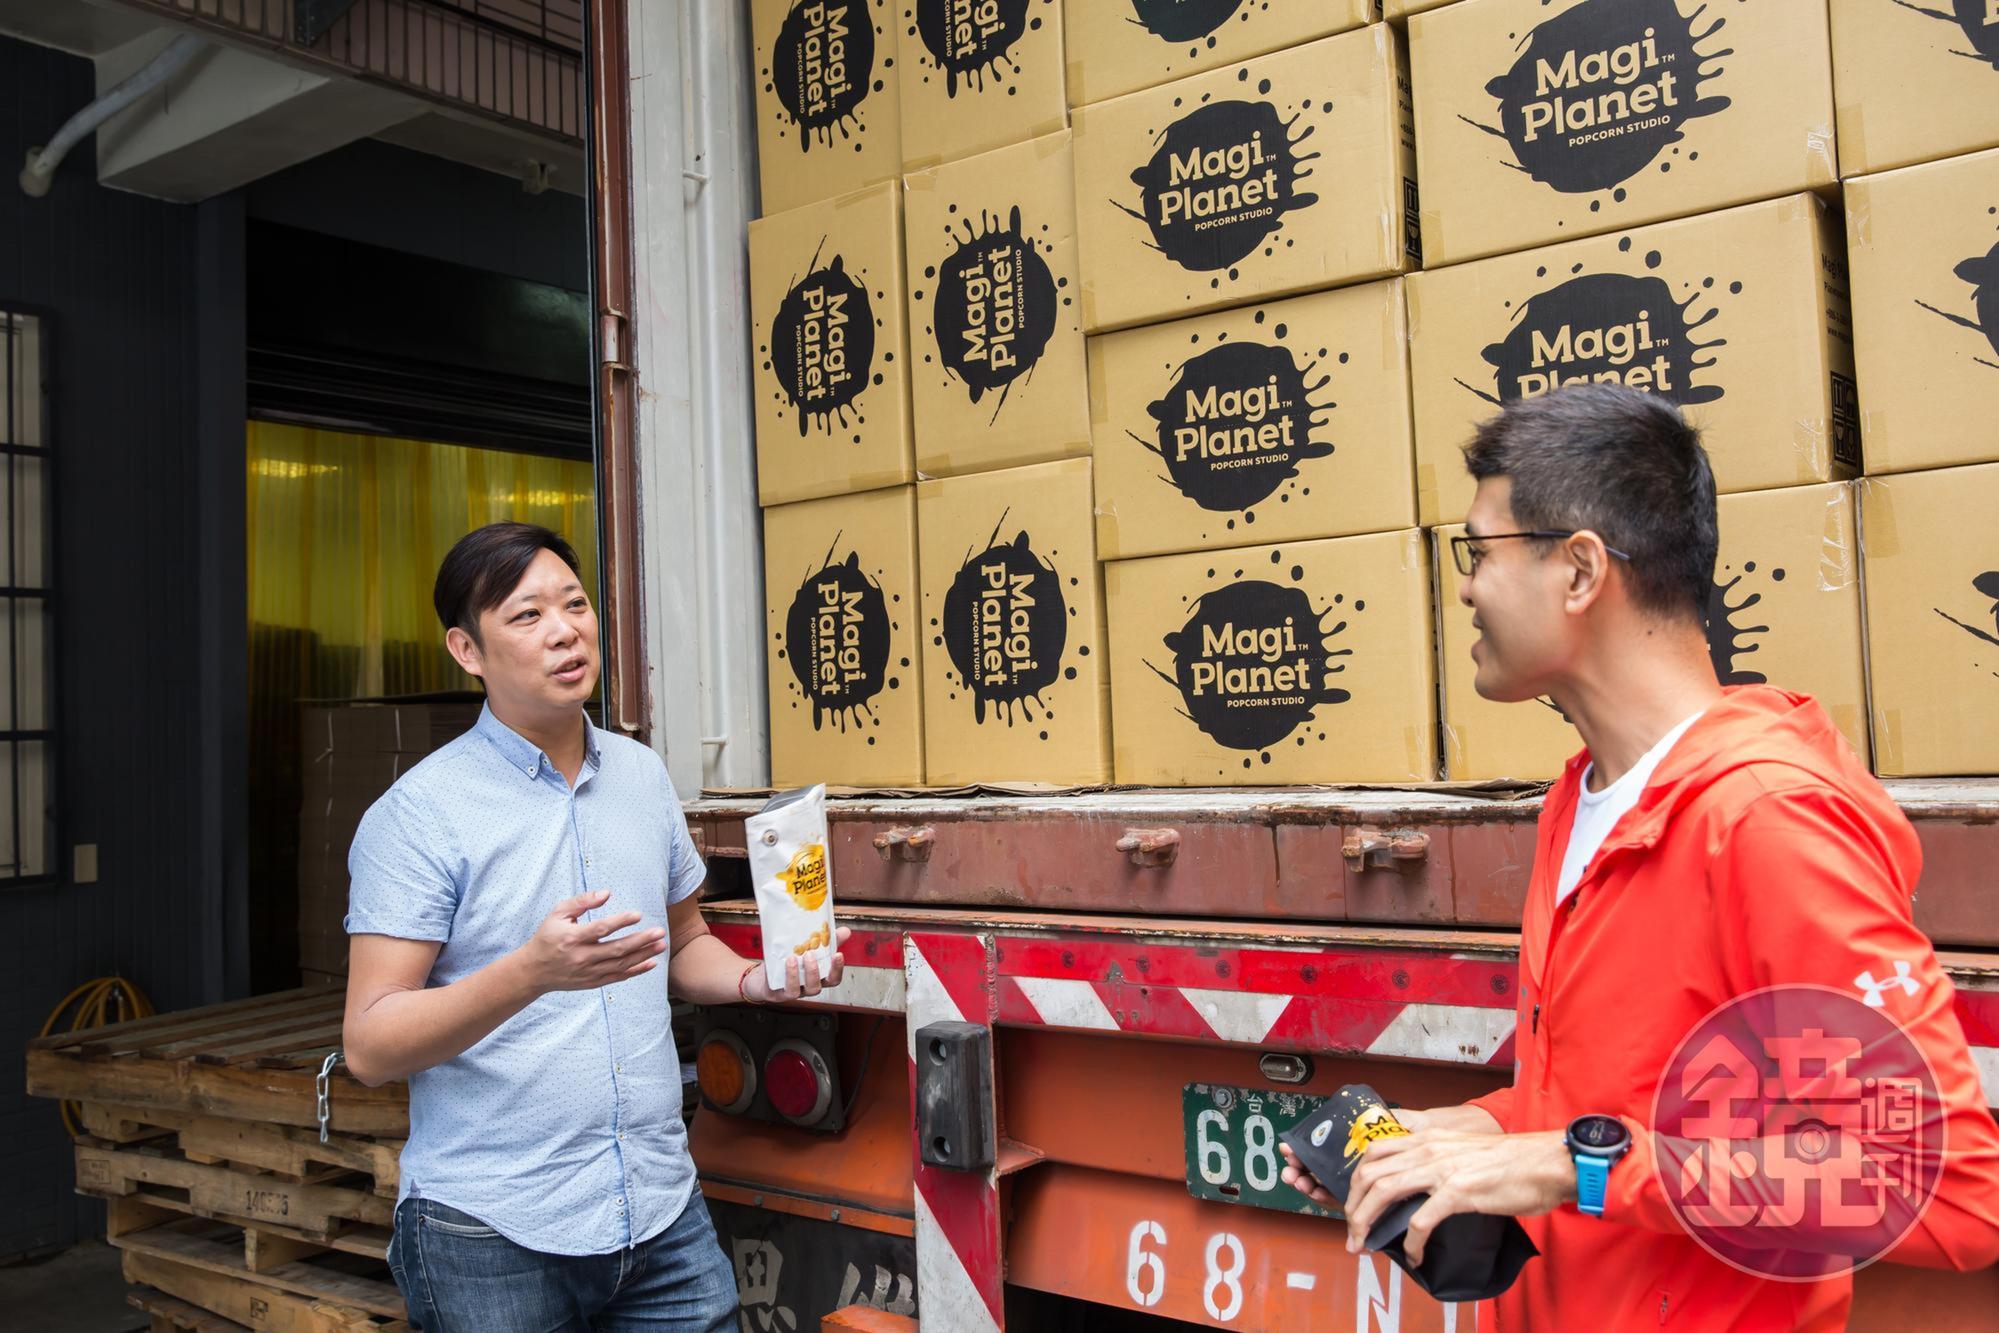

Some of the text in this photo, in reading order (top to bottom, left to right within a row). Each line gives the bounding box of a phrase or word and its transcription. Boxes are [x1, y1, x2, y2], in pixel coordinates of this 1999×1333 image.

[803, 0, 827, 117] Planet
[824, 5, 852, 98] Magi
[1535, 27, 1660, 97] Magi
[1521, 70, 1678, 143] Planet
[1568, 114, 1671, 148] POPCORN STUDIO
[1169, 130, 1264, 187] Magi
[1158, 169, 1279, 226] Planet
[1194, 206, 1273, 232] POPCORN STUDIO
[959, 263, 991, 362] Magi
[988, 245, 1016, 371] Planet
[1015, 249, 1025, 329] POPCORN STUDIO
[803, 286, 826, 401] Planet
[823, 293, 852, 385] Magi
[1531, 309, 1653, 369] Magi
[1185, 374, 1280, 423] Magi
[1174, 415, 1295, 462] Planet
[1210, 453, 1289, 472] POPCORN STUDIO
[818, 581, 840, 696] Planet
[838, 591, 867, 683] Magi
[972, 601, 981, 681] POPCORN STUDIO
[981, 562, 1007, 687] Planet
[1004, 573, 1038, 673] Magi
[1201, 616, 1297, 663] Magi
[1191, 658, 1311, 696] Planet
[1227, 696, 1305, 708] POPCORN STUDIO
